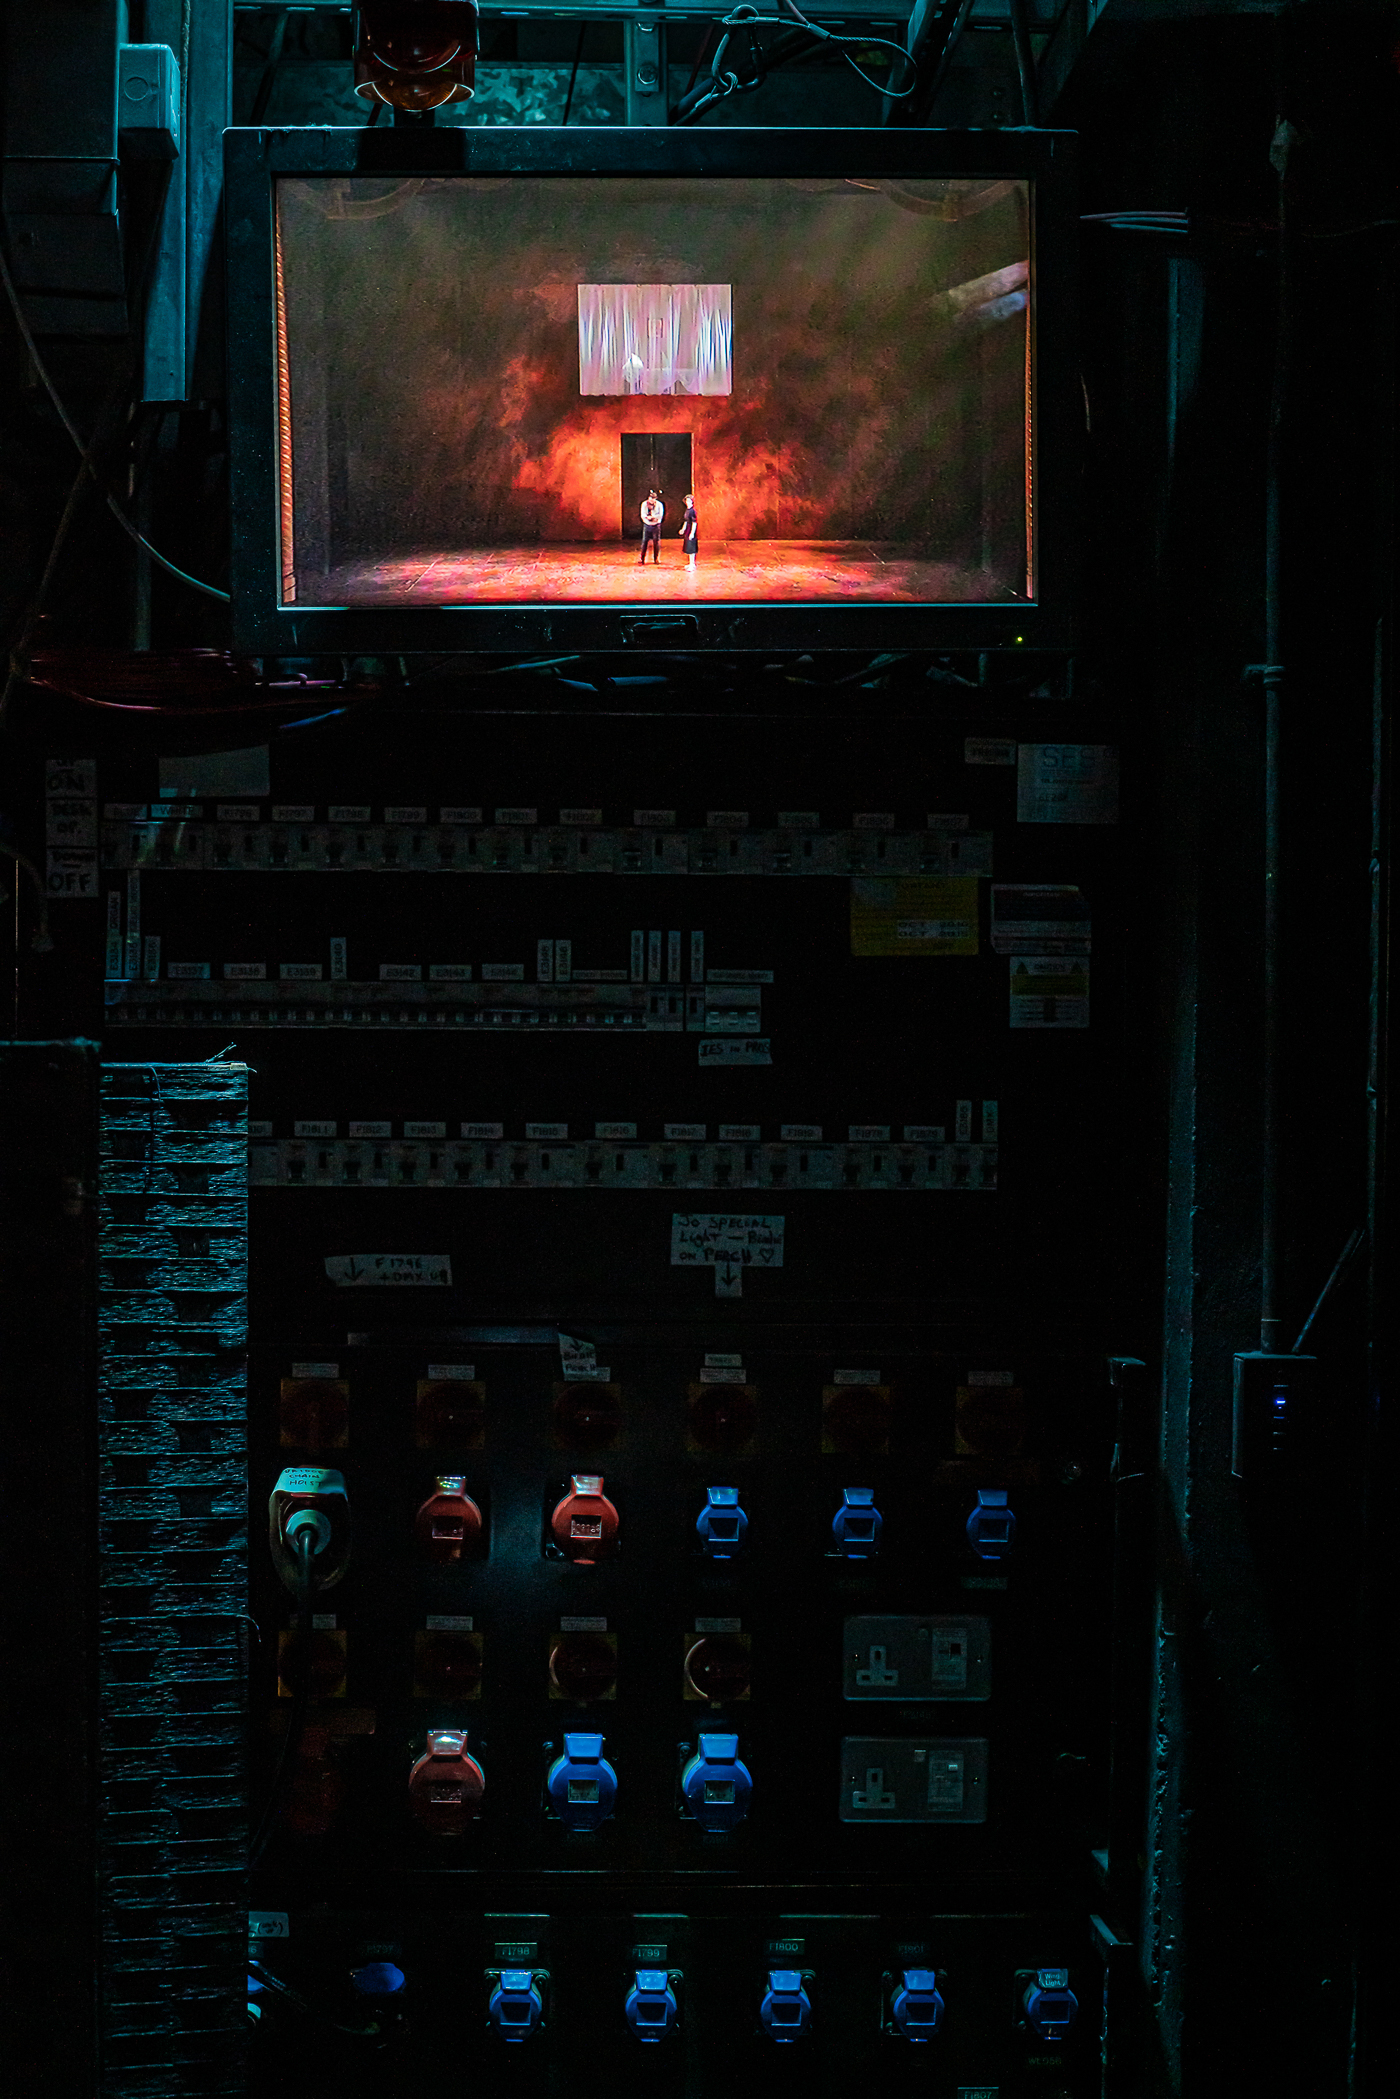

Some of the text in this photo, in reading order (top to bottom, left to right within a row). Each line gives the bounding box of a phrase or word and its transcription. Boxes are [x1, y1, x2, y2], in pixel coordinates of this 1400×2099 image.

[47, 773, 86, 791] ON
[48, 872, 91, 893] OFF
[109, 897, 118, 930] ORGAN
[334, 943, 344, 973] E3140
[175, 966, 203, 976] E3137
[435, 968, 466, 978] E3143
[986, 1111, 995, 1134] DMX
[301, 1124, 329, 1135] F1811
[355, 1125, 383, 1135] F1812
[410, 1125, 437, 1135] F1813
[467, 1126, 495, 1136] F1814
[670, 1126, 698, 1137] F1817
[709, 1217, 771, 1232] SPECIAL
[702, 1246, 752, 1266] PERCH
[289, 1479, 323, 1488] HOIST
[501, 1946, 530, 1957] F1798
[631, 1947, 661, 1958] F1799
[768, 1942, 799, 1952] F1800
